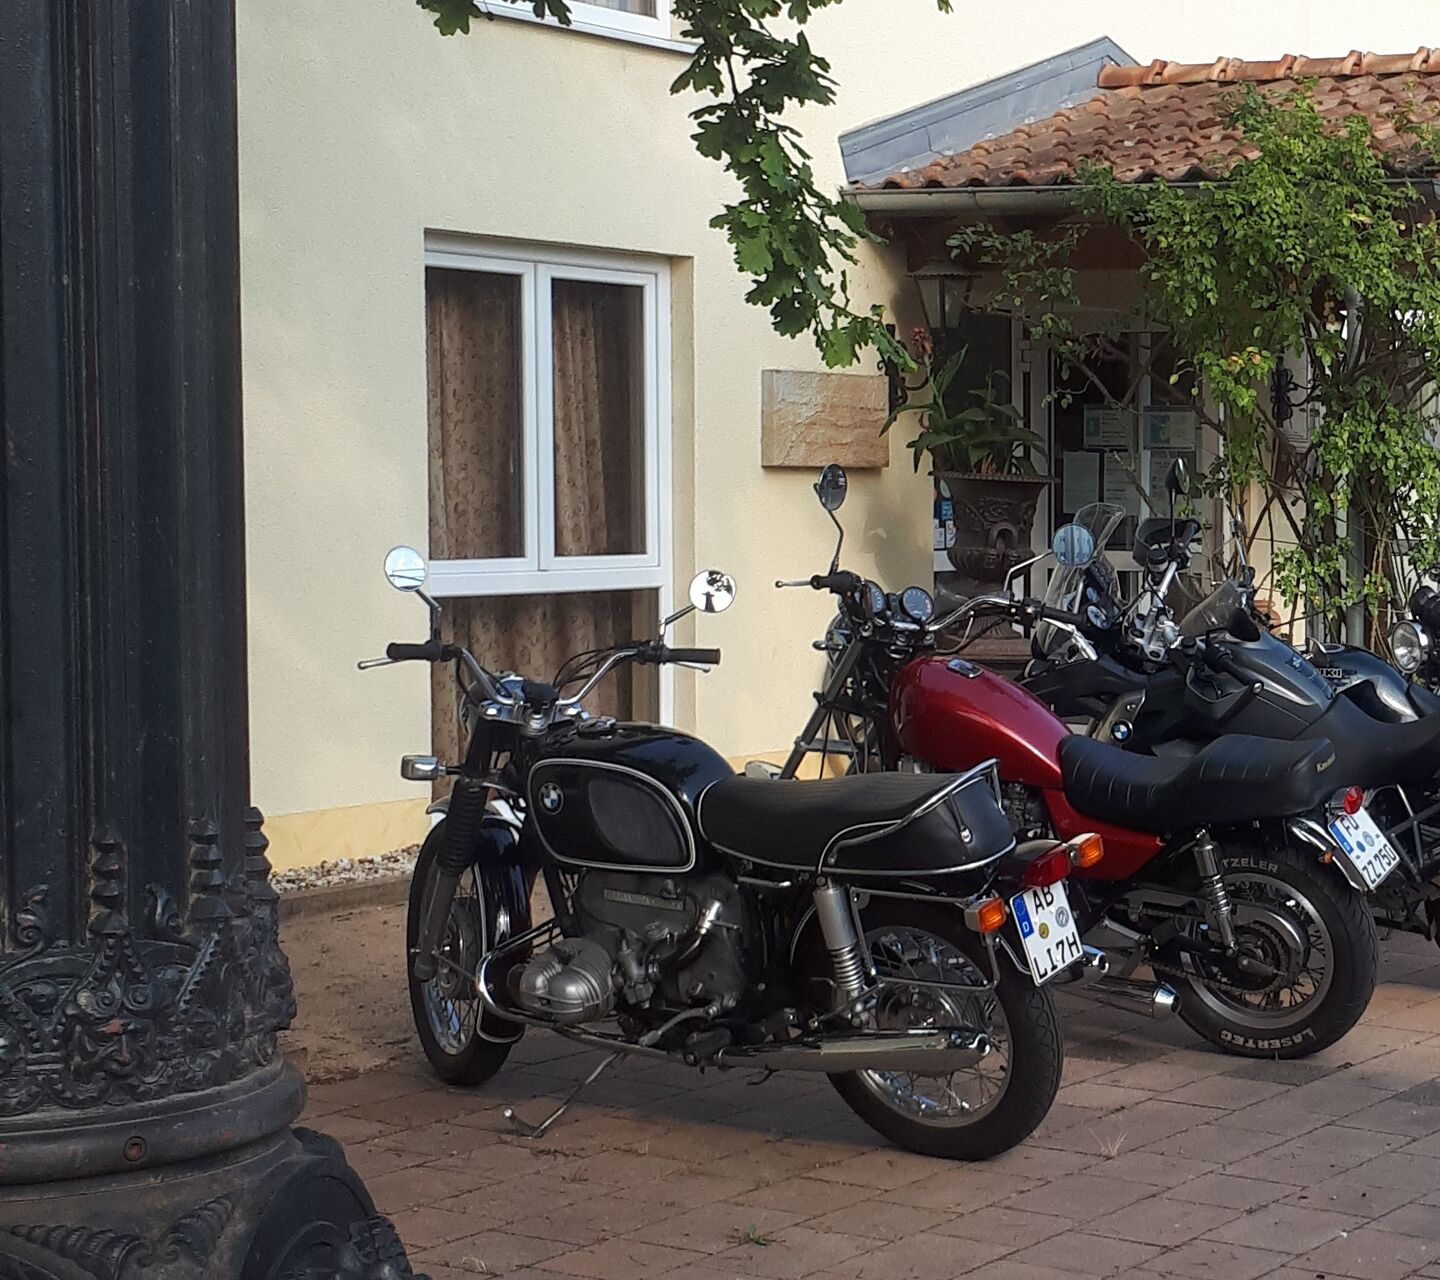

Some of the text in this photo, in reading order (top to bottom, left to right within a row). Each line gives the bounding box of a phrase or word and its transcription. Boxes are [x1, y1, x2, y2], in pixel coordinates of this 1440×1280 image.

[1221, 855, 1279, 873] TZELER
[1033, 884, 1055, 914] AB
[1023, 922, 1031, 933] D
[1219, 1027, 1318, 1050] LASERTEC
